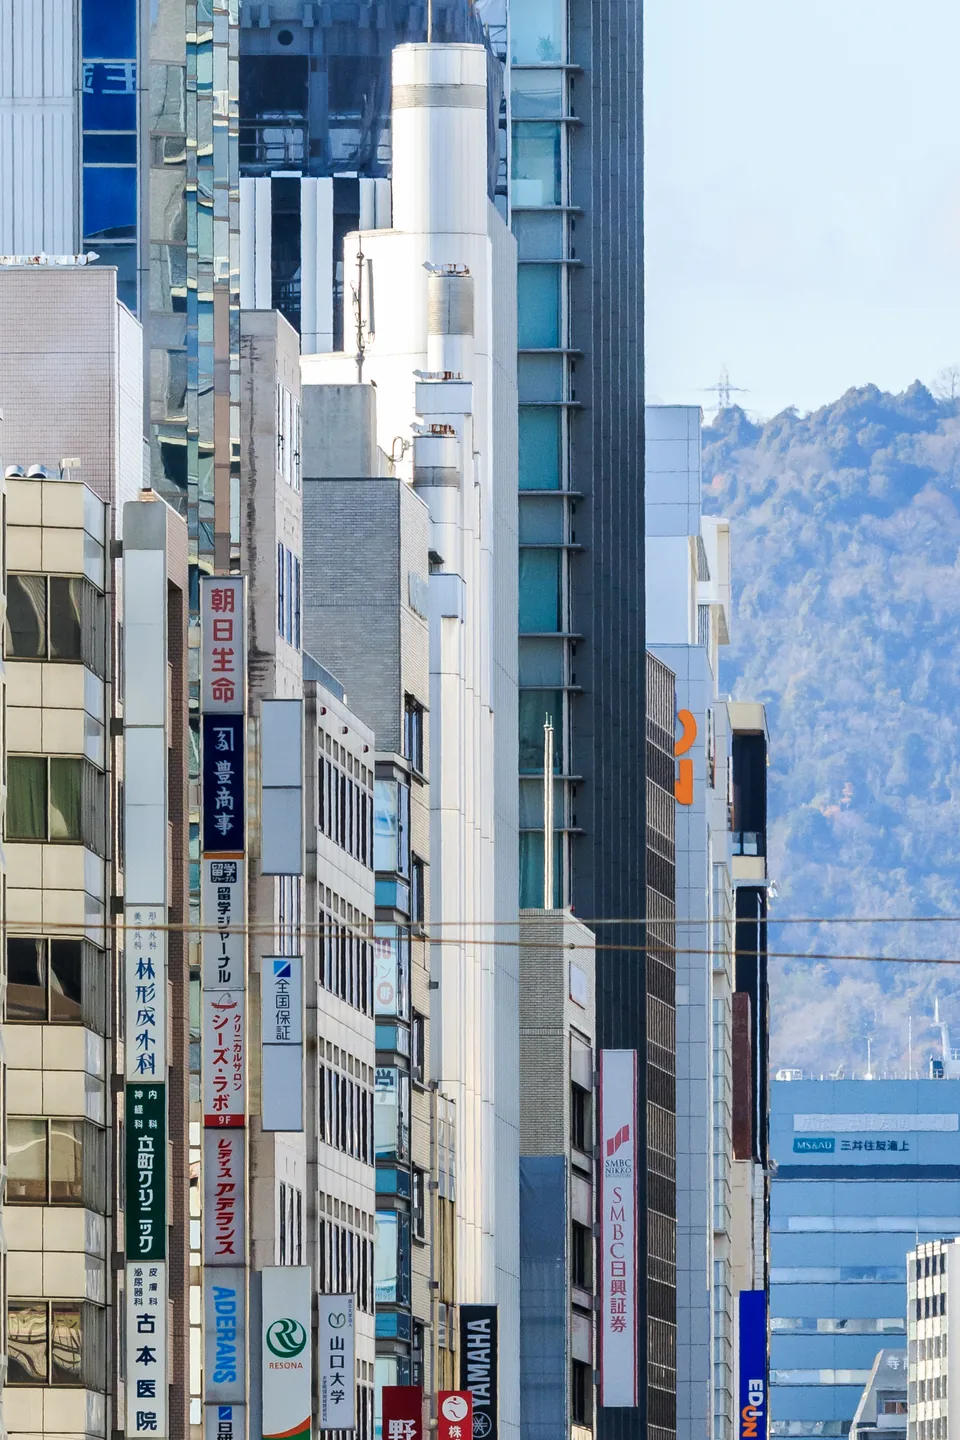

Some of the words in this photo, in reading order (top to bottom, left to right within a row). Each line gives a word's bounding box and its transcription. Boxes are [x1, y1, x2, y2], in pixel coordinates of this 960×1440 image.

[211, 587, 235, 703] 朝日生命
[213, 760, 235, 836] 豊商事
[211, 863, 236, 877] 留学
[217, 887, 231, 983] 留学ジャーナル
[133, 957, 156, 1075] 林形成外科
[275, 979, 291, 1041] 全国保証
[212, 1015, 230, 1112] シーズ・ラボ
[232, 1014, 242, 1091] クリニカルサロン
[134, 1090, 144, 1129] 神経科
[148, 1090, 158, 1129] 内科
[218, 1115, 231, 1125] 9F
[217, 1138, 233, 1178] レディス
[605, 1159, 632, 1167] SMBC
[797, 1141, 832, 1150] MS&AD
[840, 1140, 910, 1152] 三井住友海上
[137, 1135, 154, 1253] 立町クリニック
[215, 1183, 236, 1256] アデランス
[134, 1268, 143, 1306] 泌尿器科
[149, 1268, 158, 1306] 皮膚科
[610, 1187, 627, 1333] SMBC日興証券
[213, 1286, 236, 1384] ADERANS
[330, 1336, 345, 1404] 山口大学
[467, 1318, 491, 1407] YAMAHA
[134, 1313, 157, 1431] 古本医院
[742, 1379, 764, 1438] EDION
